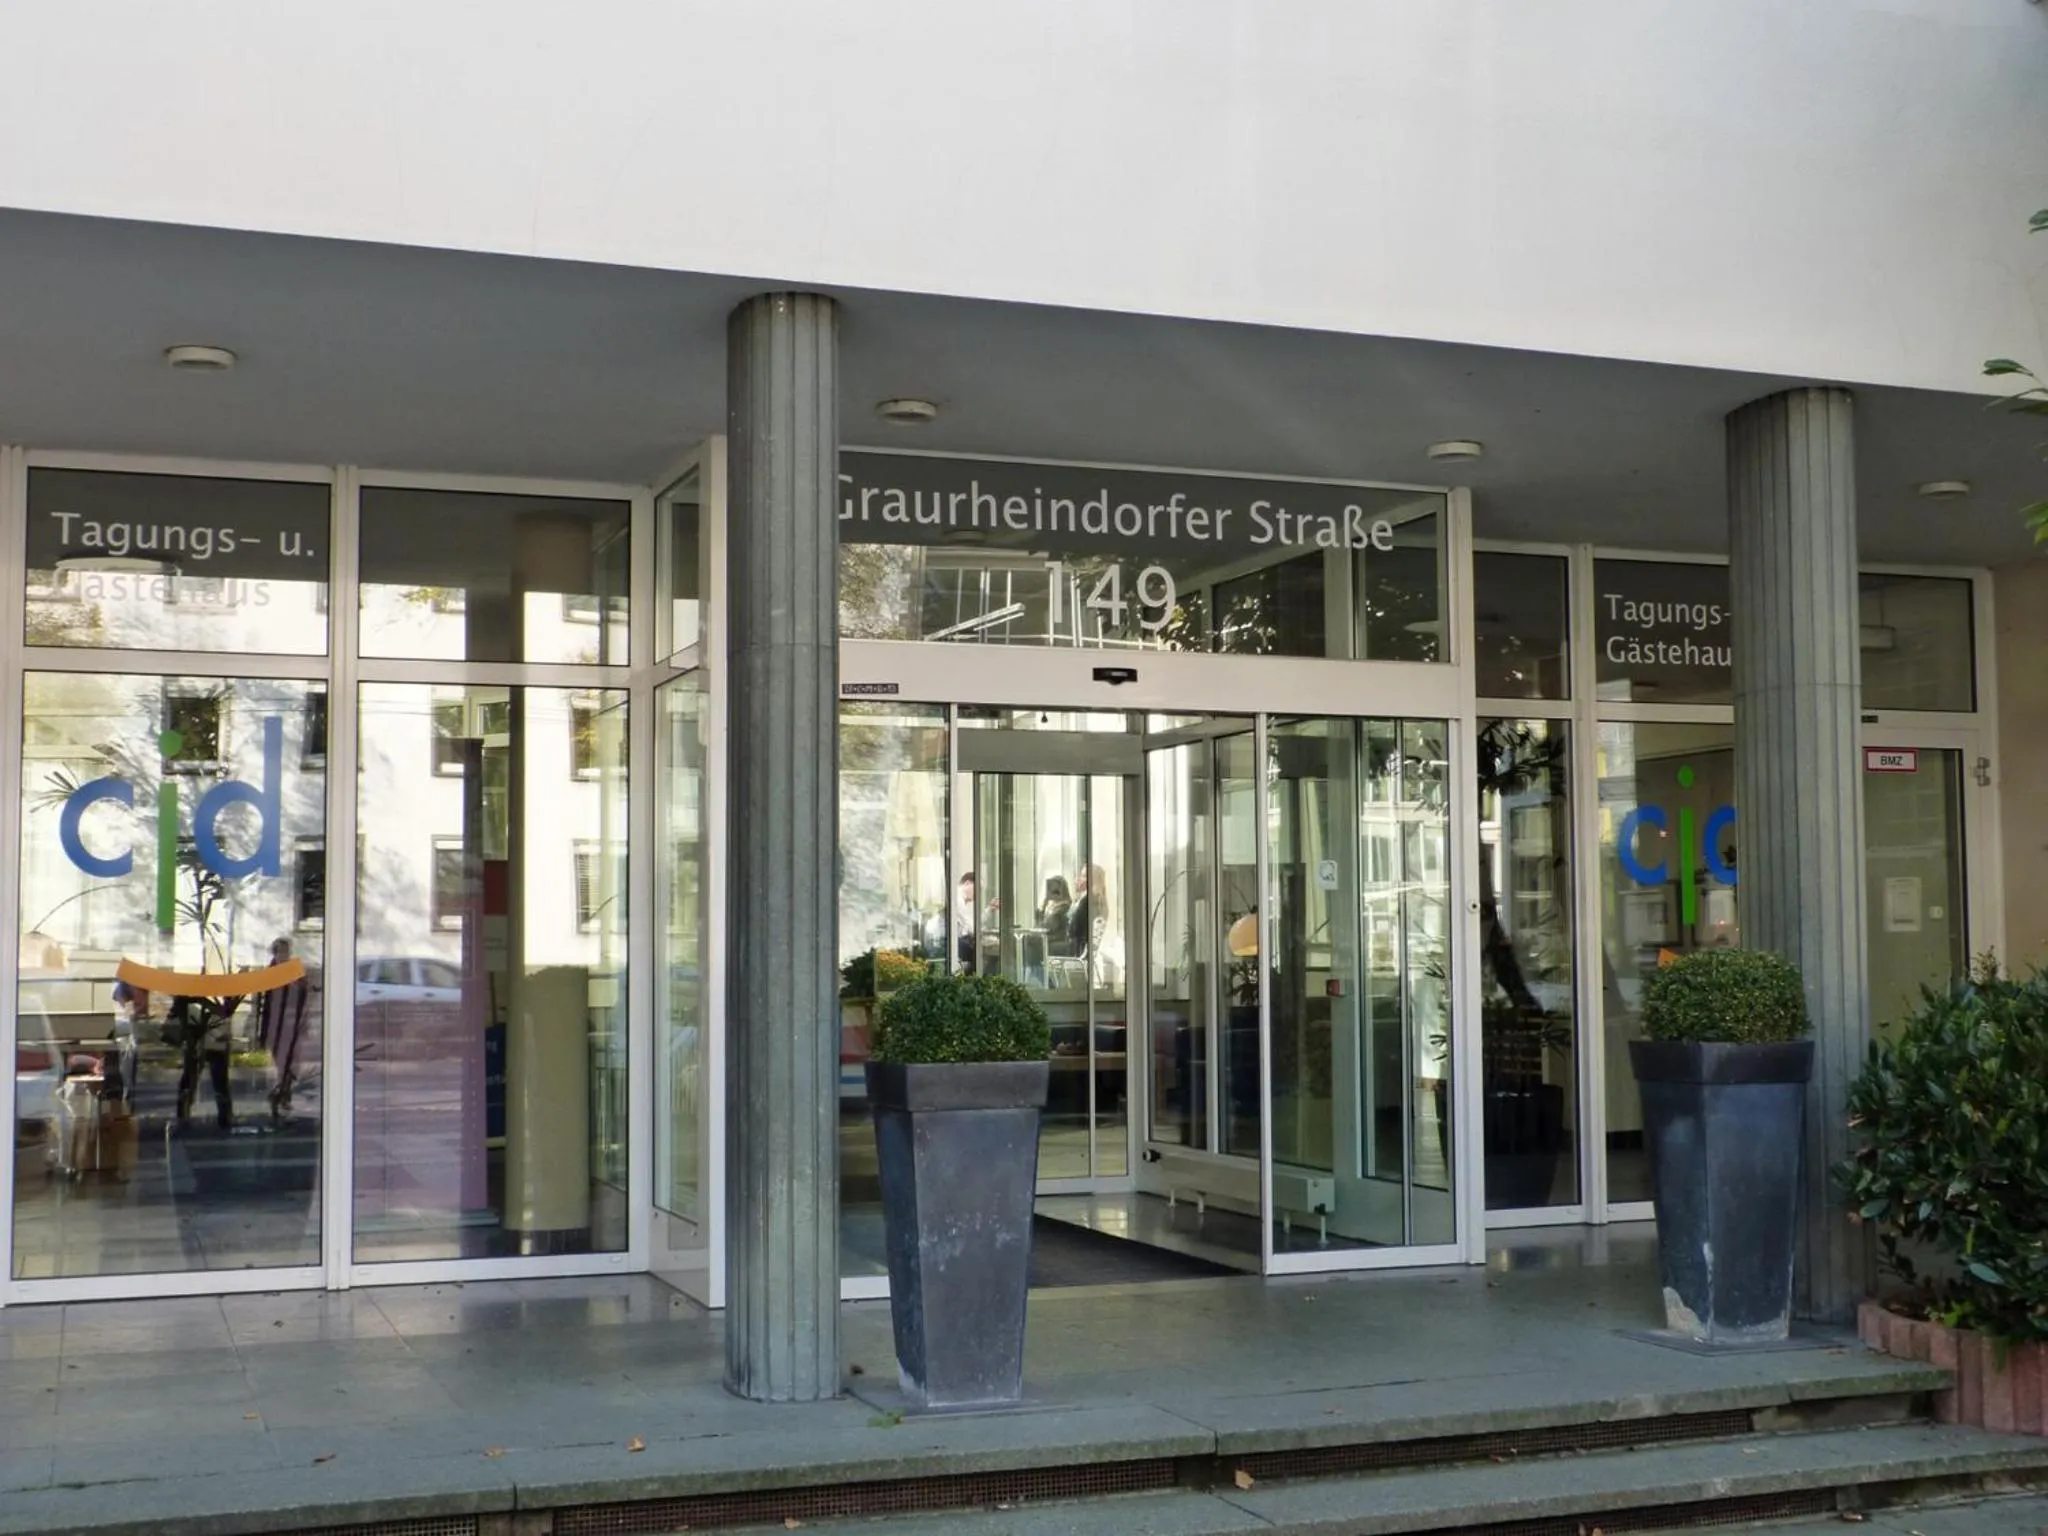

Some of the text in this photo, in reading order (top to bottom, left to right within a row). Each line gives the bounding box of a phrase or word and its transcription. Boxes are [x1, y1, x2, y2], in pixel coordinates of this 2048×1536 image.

[279, 530, 315, 557] u.
[1250, 500, 1393, 551] Straße
[1044, 560, 1177, 631] 149
[1880, 755, 1905, 767] BMZ
